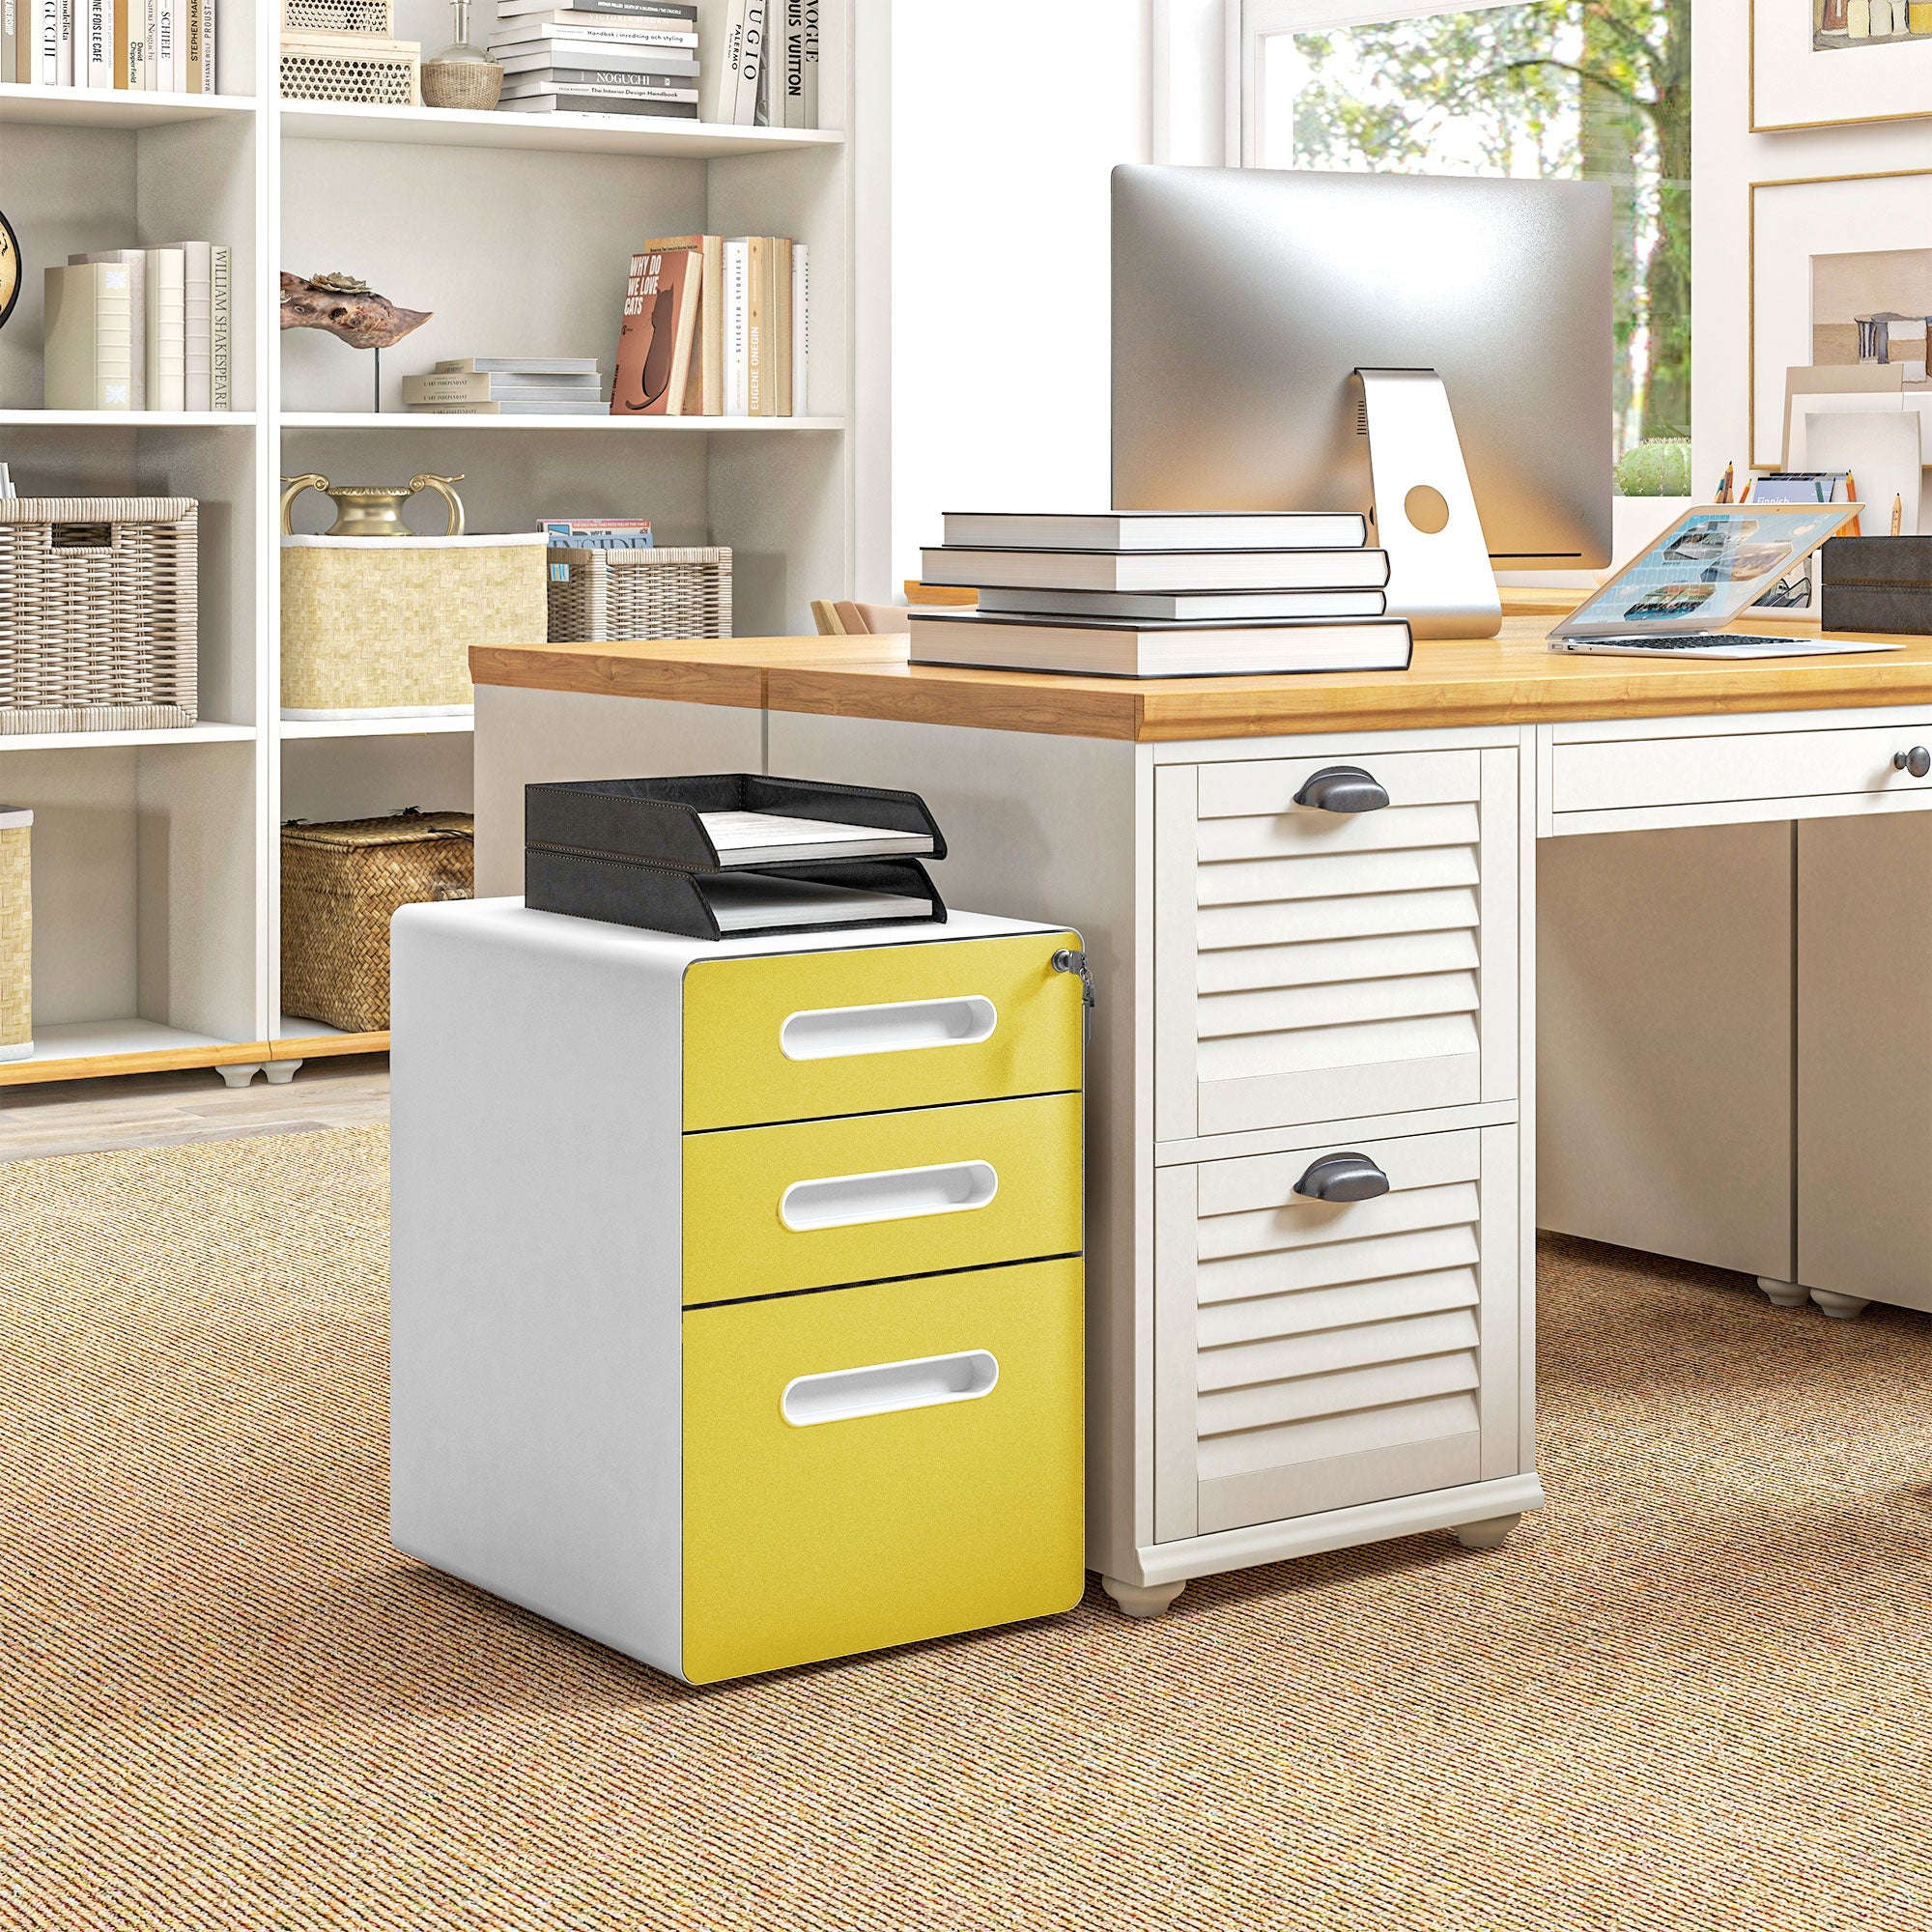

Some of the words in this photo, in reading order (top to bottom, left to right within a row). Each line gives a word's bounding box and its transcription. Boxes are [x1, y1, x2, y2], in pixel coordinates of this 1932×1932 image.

[4, 0, 14, 36] EADERSHIP
[93, 14, 101, 31] FOIS
[588, 14, 634, 22] VICTORIA
[788, 0, 801, 26] UIS
[806, 0, 819, 62] VOGUE
[93, 33, 101, 42] LE
[93, 43, 103, 63] CAFÉ
[146, 23, 156, 61] Noguchi
[160, 11, 171, 59] SCHIELE
[190, 20, 199, 62] STEPHEN
[731, 24, 742, 71] PALERMO
[596, 72, 650, 86] NOGUCHI
[788, 35, 802, 97] VUITTON
[214, 250, 227, 312] WILLIAM
[630, 255, 648, 277] WHY
[649, 254, 662, 276] DO
[628, 277, 640, 297] WE
[640, 276, 659, 296] LOVE
[624, 296, 643, 316] CATS
[214, 316, 227, 409] SHAKESPEARE
[751, 327, 759, 366] ONEGIN
[751, 369, 759, 411] EUGENE
